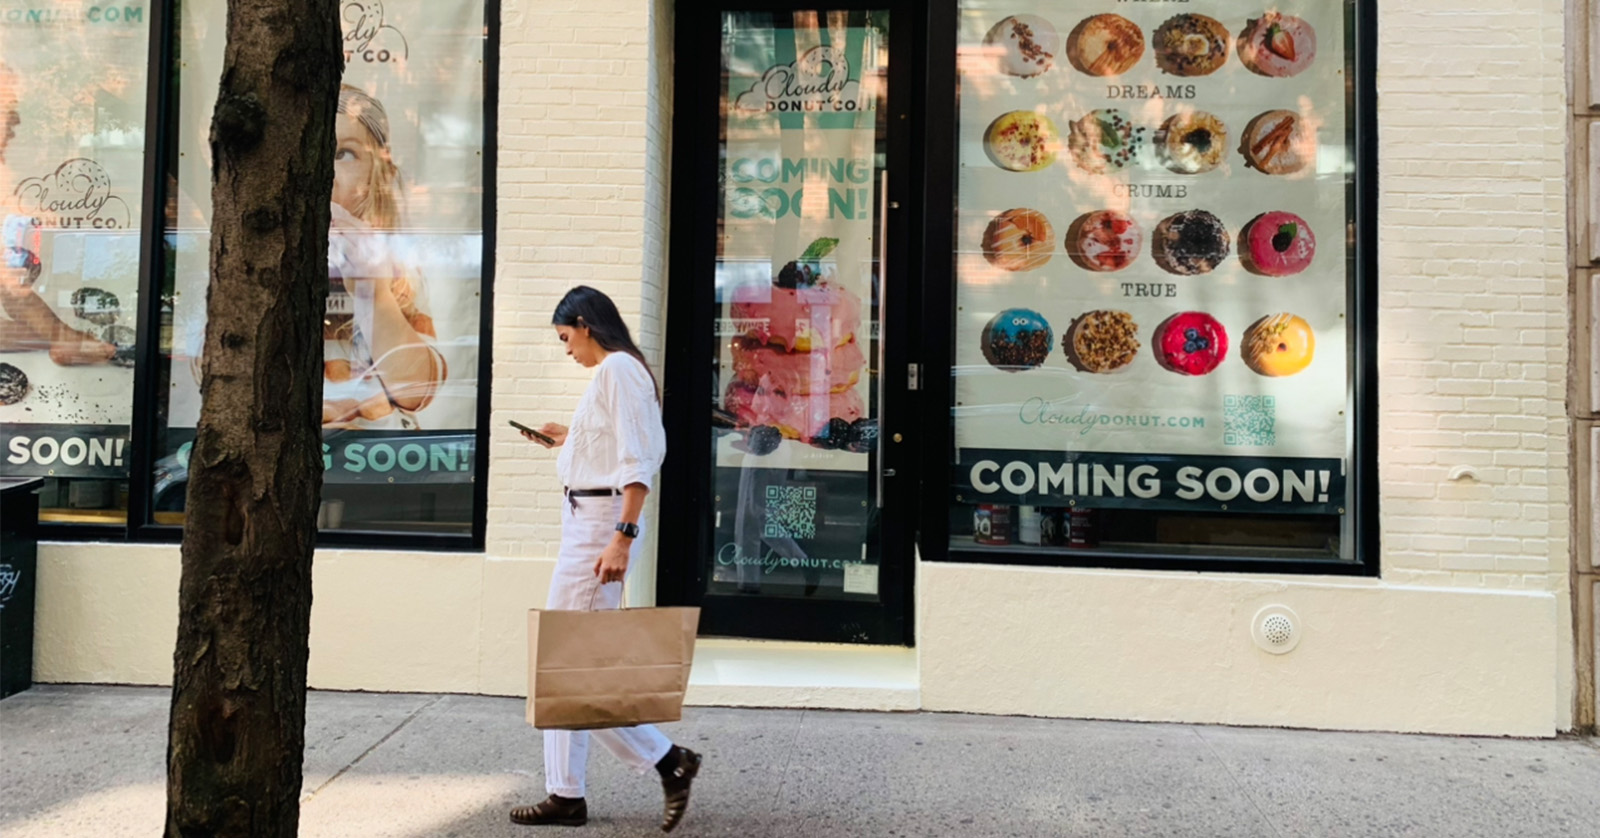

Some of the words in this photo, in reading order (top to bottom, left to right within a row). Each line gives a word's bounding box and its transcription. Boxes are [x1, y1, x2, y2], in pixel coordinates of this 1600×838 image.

[363, 49, 397, 63] CO.
[765, 69, 847, 103] Cloudy
[1106, 84, 1197, 99] DREAMS
[765, 100, 825, 112] DONUT
[832, 100, 862, 112] CO.
[731, 157, 870, 184] COMING
[18, 183, 107, 219] Cloudy
[1112, 184, 1188, 198] CRUMB
[30, 216, 84, 229] ONUT
[92, 217, 123, 229] CO.
[1121, 283, 1178, 297] TRUE
[7, 435, 125, 467] SOON!
[343, 442, 470, 473] SOON!
[969, 459, 1161, 499] COMING
[1175, 464, 1331, 503] SOON!
